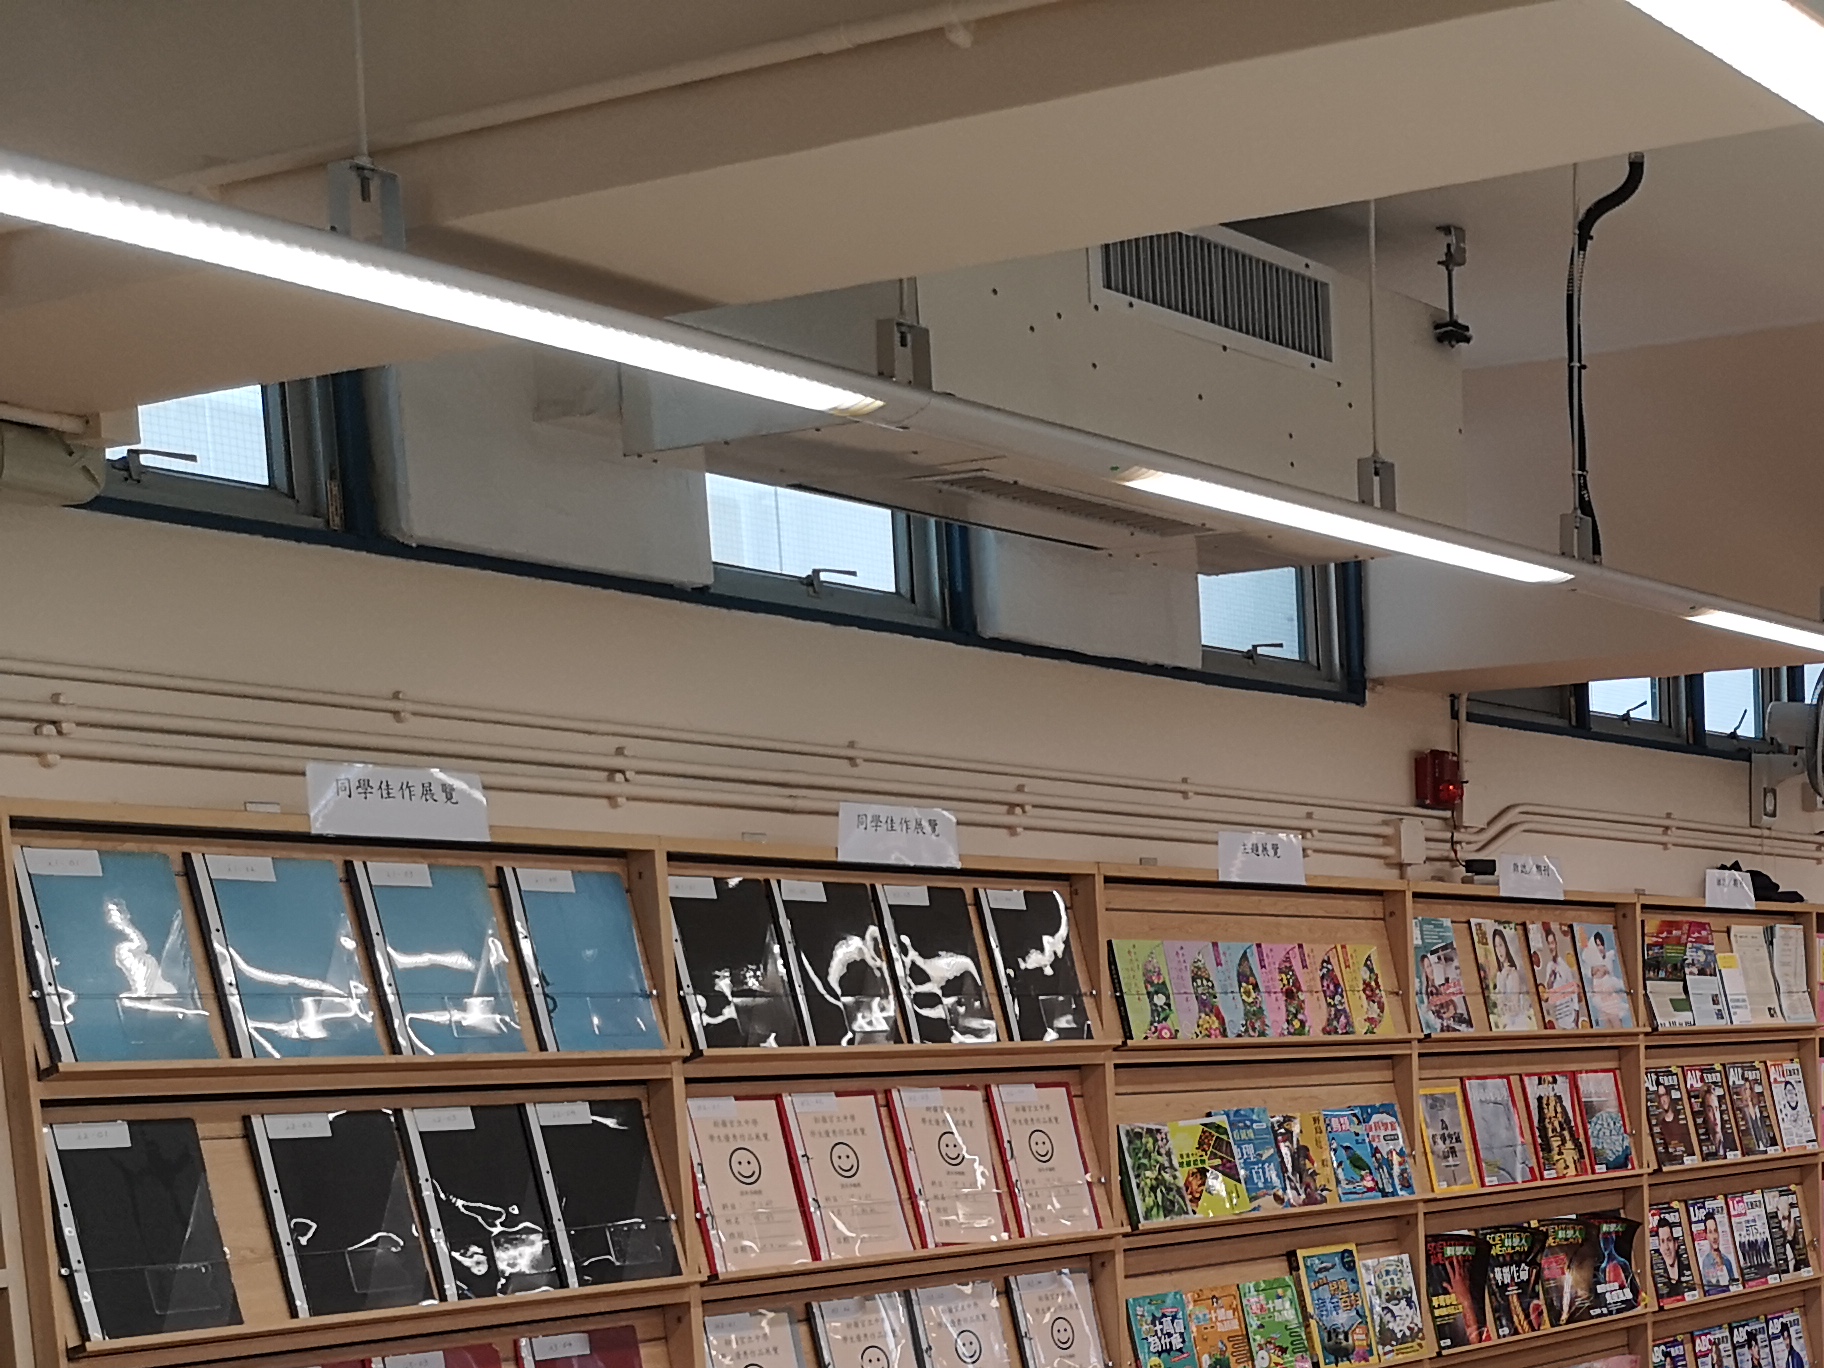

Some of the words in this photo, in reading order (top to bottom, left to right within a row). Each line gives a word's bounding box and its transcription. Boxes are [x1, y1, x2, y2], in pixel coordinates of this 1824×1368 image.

[333, 776, 459, 807] 同學佳作展覽
[856, 812, 941, 838] 同學佳作展覽
